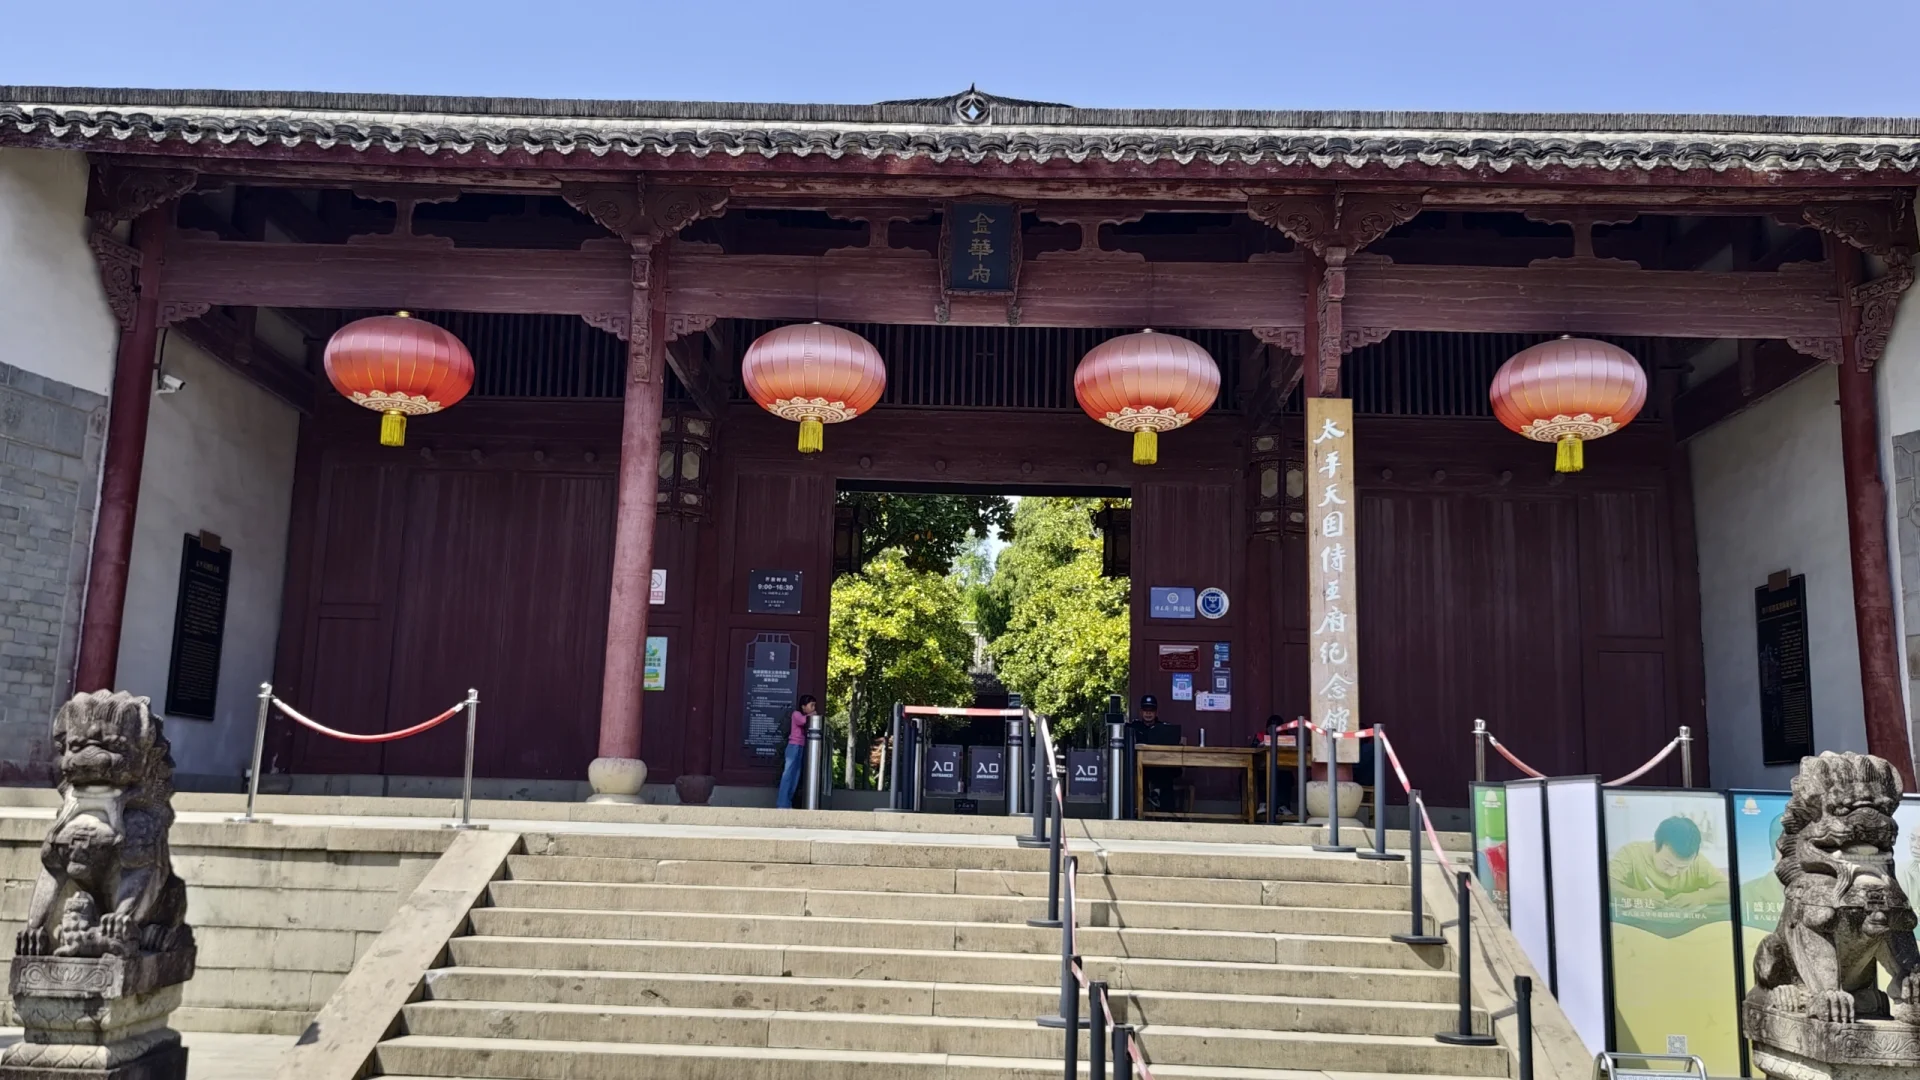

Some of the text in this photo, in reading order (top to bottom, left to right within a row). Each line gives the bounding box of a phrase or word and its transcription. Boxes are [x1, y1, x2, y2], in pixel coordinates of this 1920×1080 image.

[931, 760, 954, 772] 入口
[976, 762, 999, 774] 入口
[1075, 764, 1098, 776] 入口
